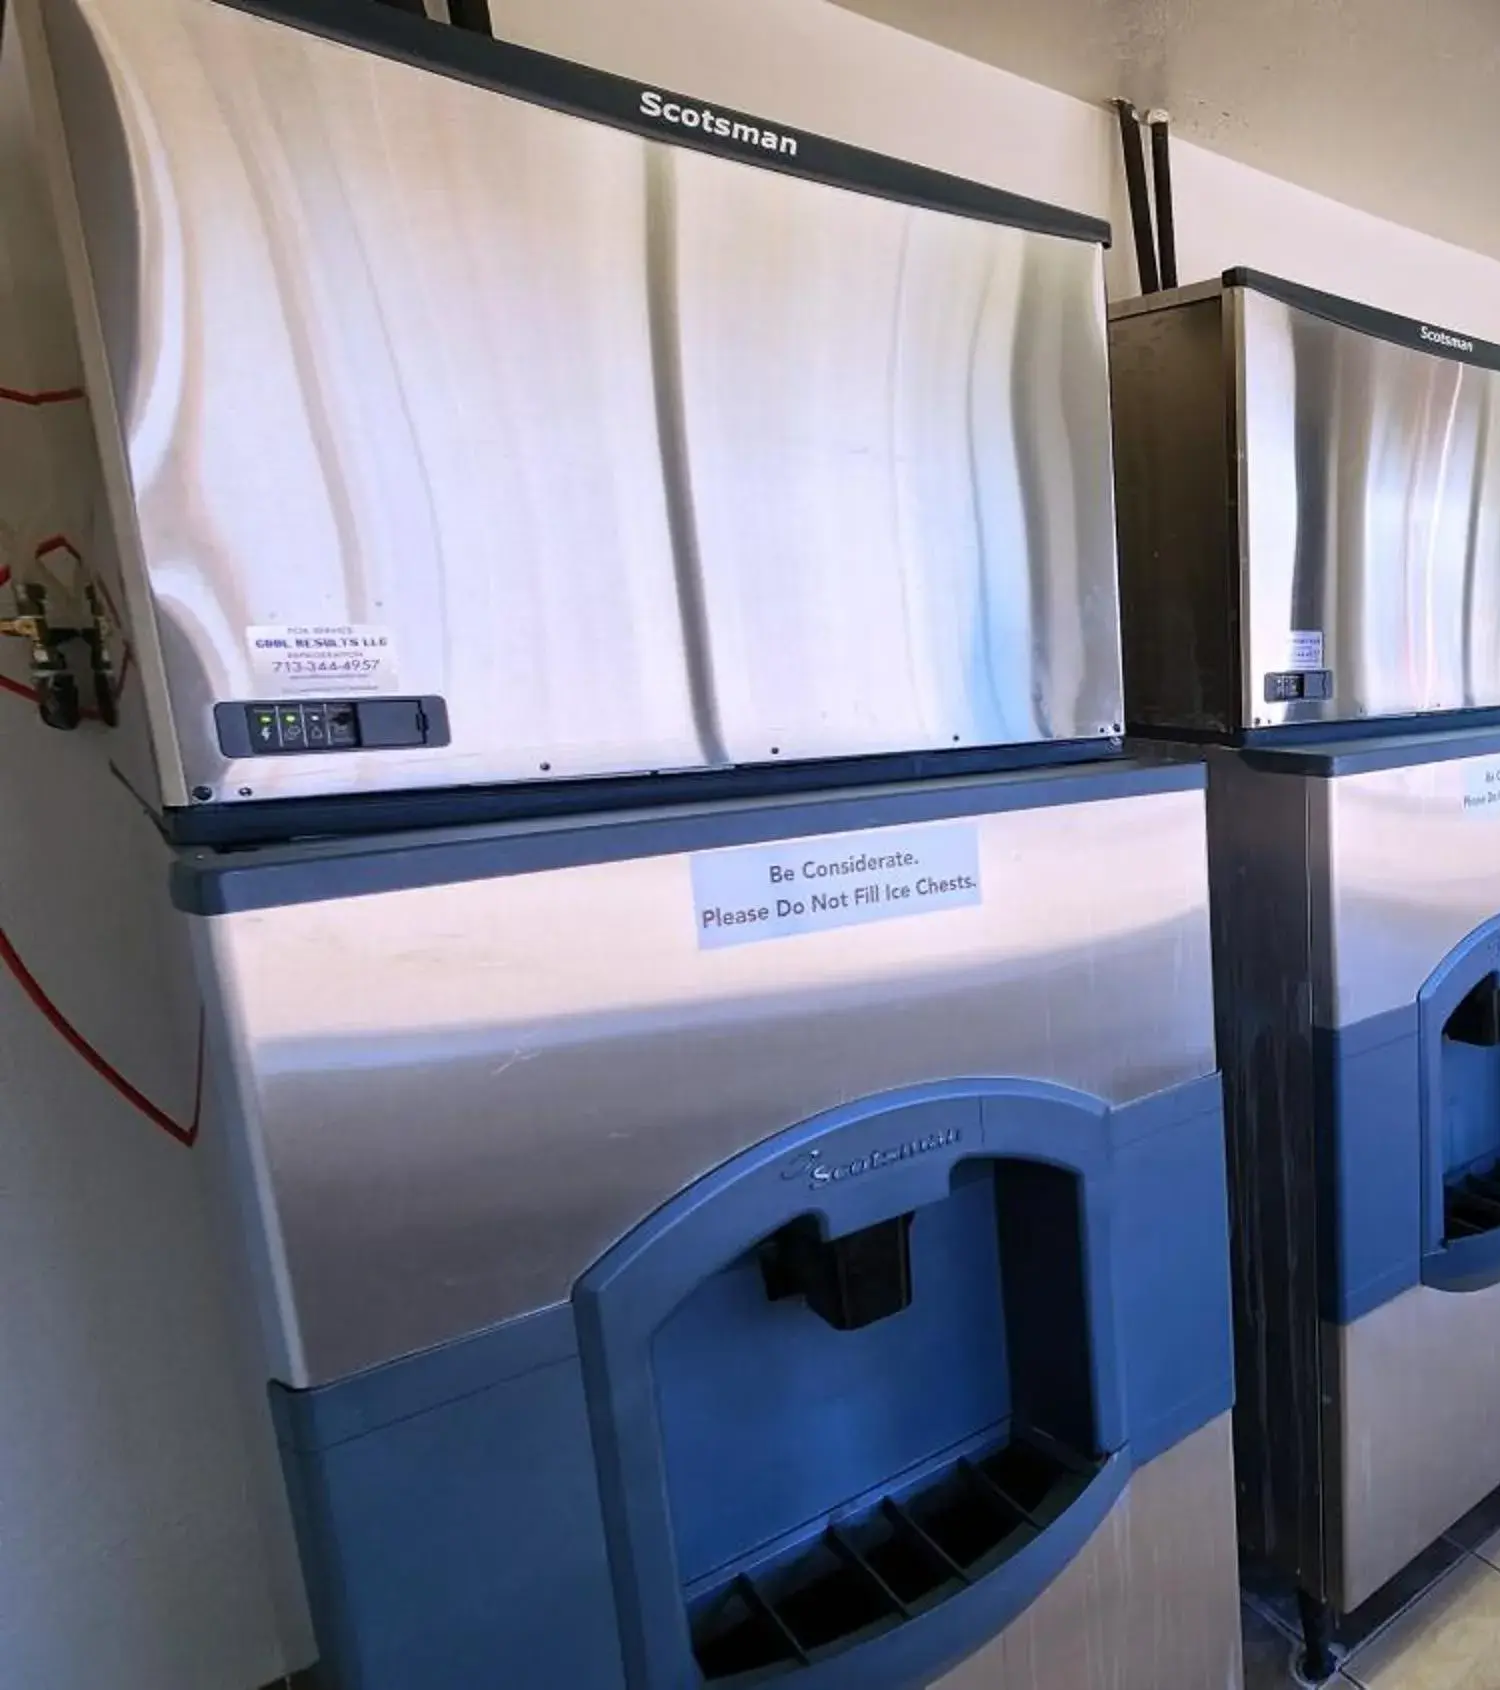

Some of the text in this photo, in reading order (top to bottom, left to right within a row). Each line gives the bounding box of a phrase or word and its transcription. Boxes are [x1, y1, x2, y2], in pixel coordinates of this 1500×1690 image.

[640, 91, 797, 155] Scotsman
[1420, 326, 1473, 352] Scotsman
[271, 659, 380, 672] 713-344-4957
[769, 850, 919, 883] Be Considerate.
[701, 873, 977, 928] Please Do Not Fill Ice Chests.
[780, 1128, 962, 1190] Scotsman
